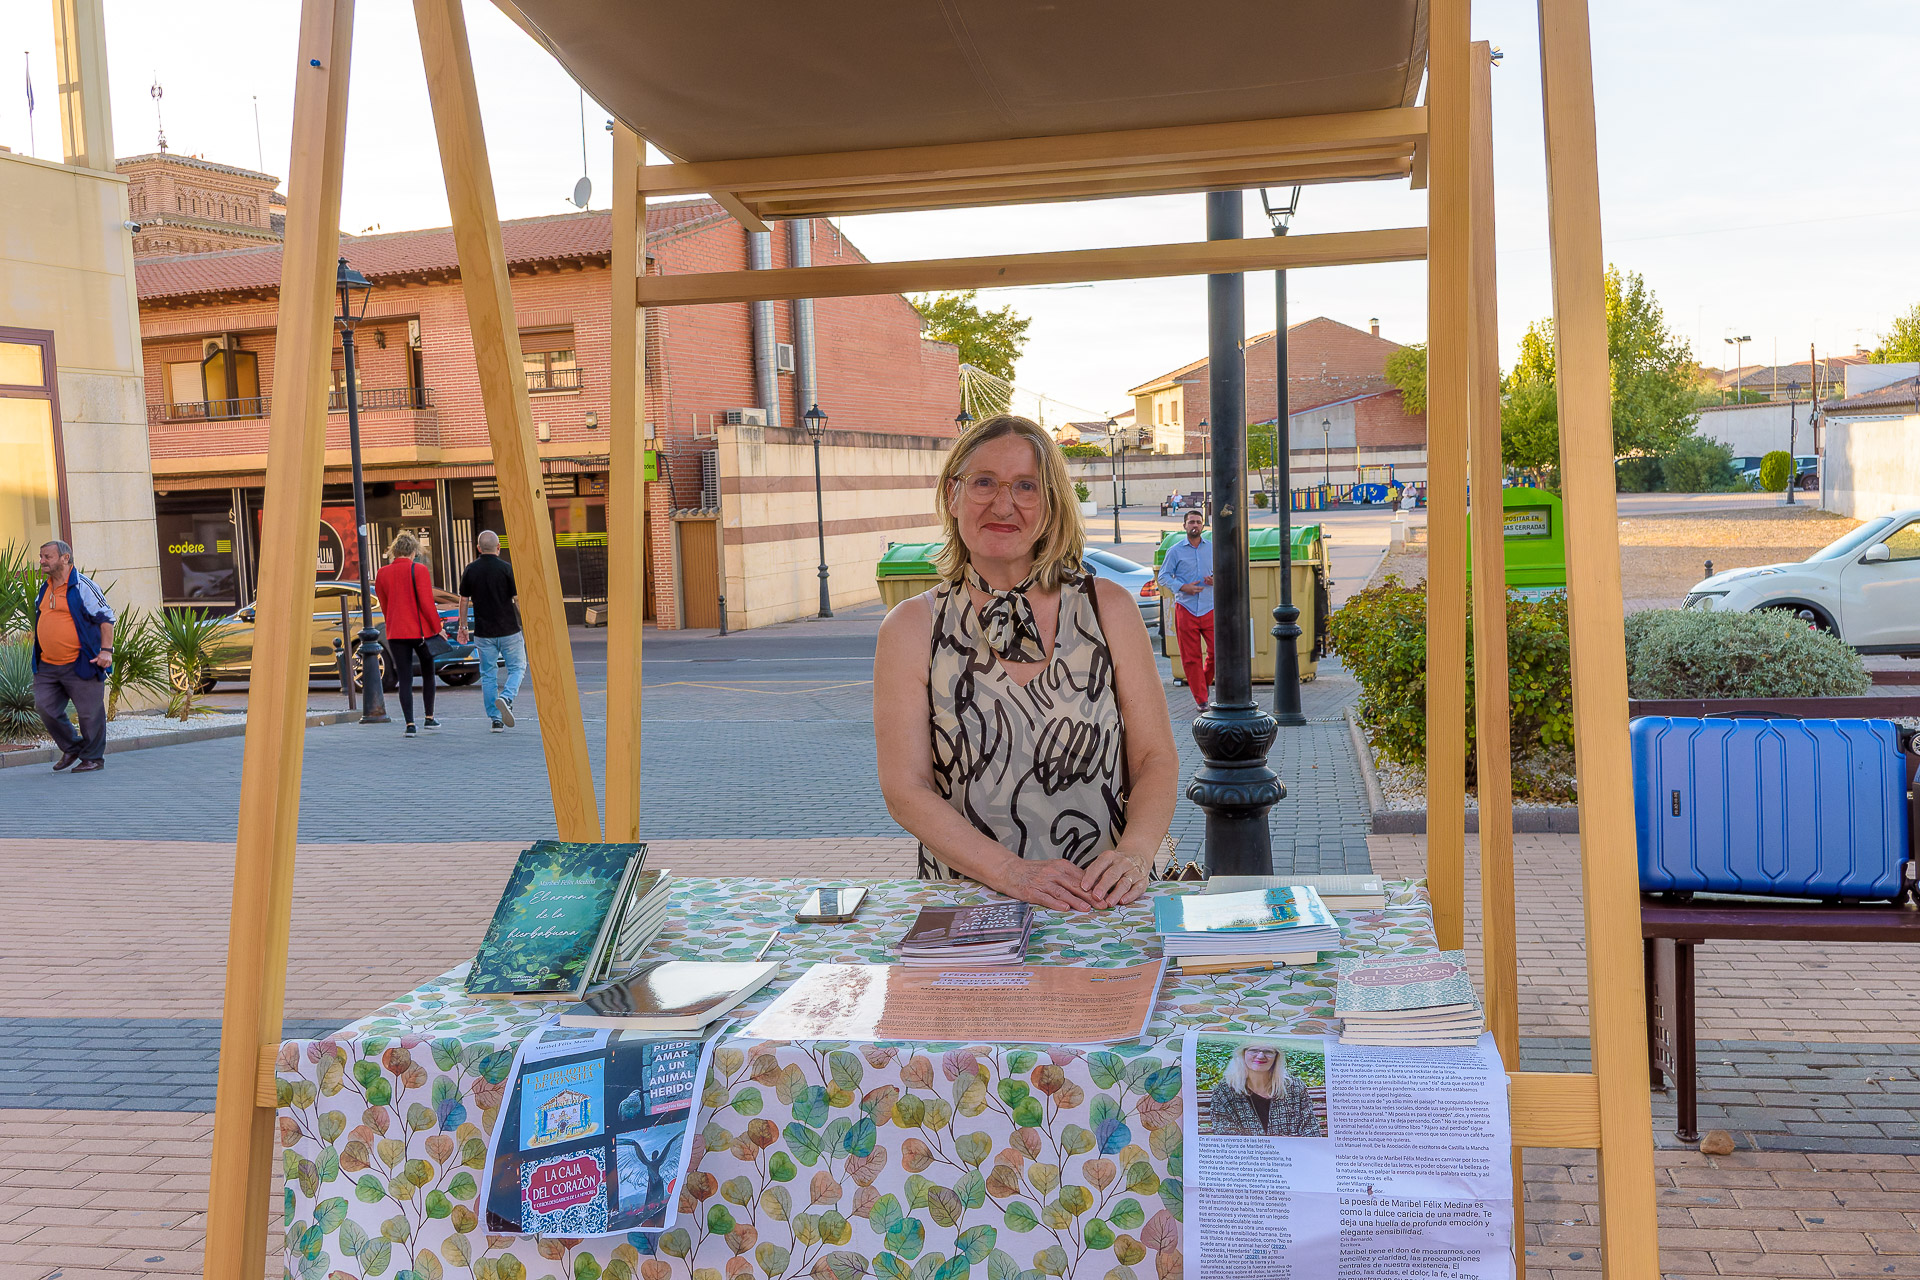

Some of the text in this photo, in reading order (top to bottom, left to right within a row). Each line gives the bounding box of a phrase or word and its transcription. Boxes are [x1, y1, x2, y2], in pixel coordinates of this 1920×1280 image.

[400, 492, 432, 510] PODIUM
[169, 540, 204, 553] codere
[529, 891, 551, 904] El
[536, 908, 566, 918] de la
[507, 926, 579, 938] hierbabuena
[654, 1041, 691, 1052] PUEDE
[655, 1050, 689, 1062] AMAR
[669, 1061, 685, 1070] UN
[543, 1063, 602, 1081] BIBLIOTECA
[649, 1070, 694, 1086] ANIMAL
[650, 1082, 693, 1098] HERIDO
[544, 1164, 581, 1182] LA CAJA
[533, 1174, 596, 1201] DEL CORAZÓN
[1352, 1198, 1377, 1207] poesía
[1340, 1219, 1356, 1227] deja
[1413, 1220, 1447, 1228] profunda
[1340, 1229, 1373, 1237] elegante
[1441, 1270, 1450, 1278] fe,
